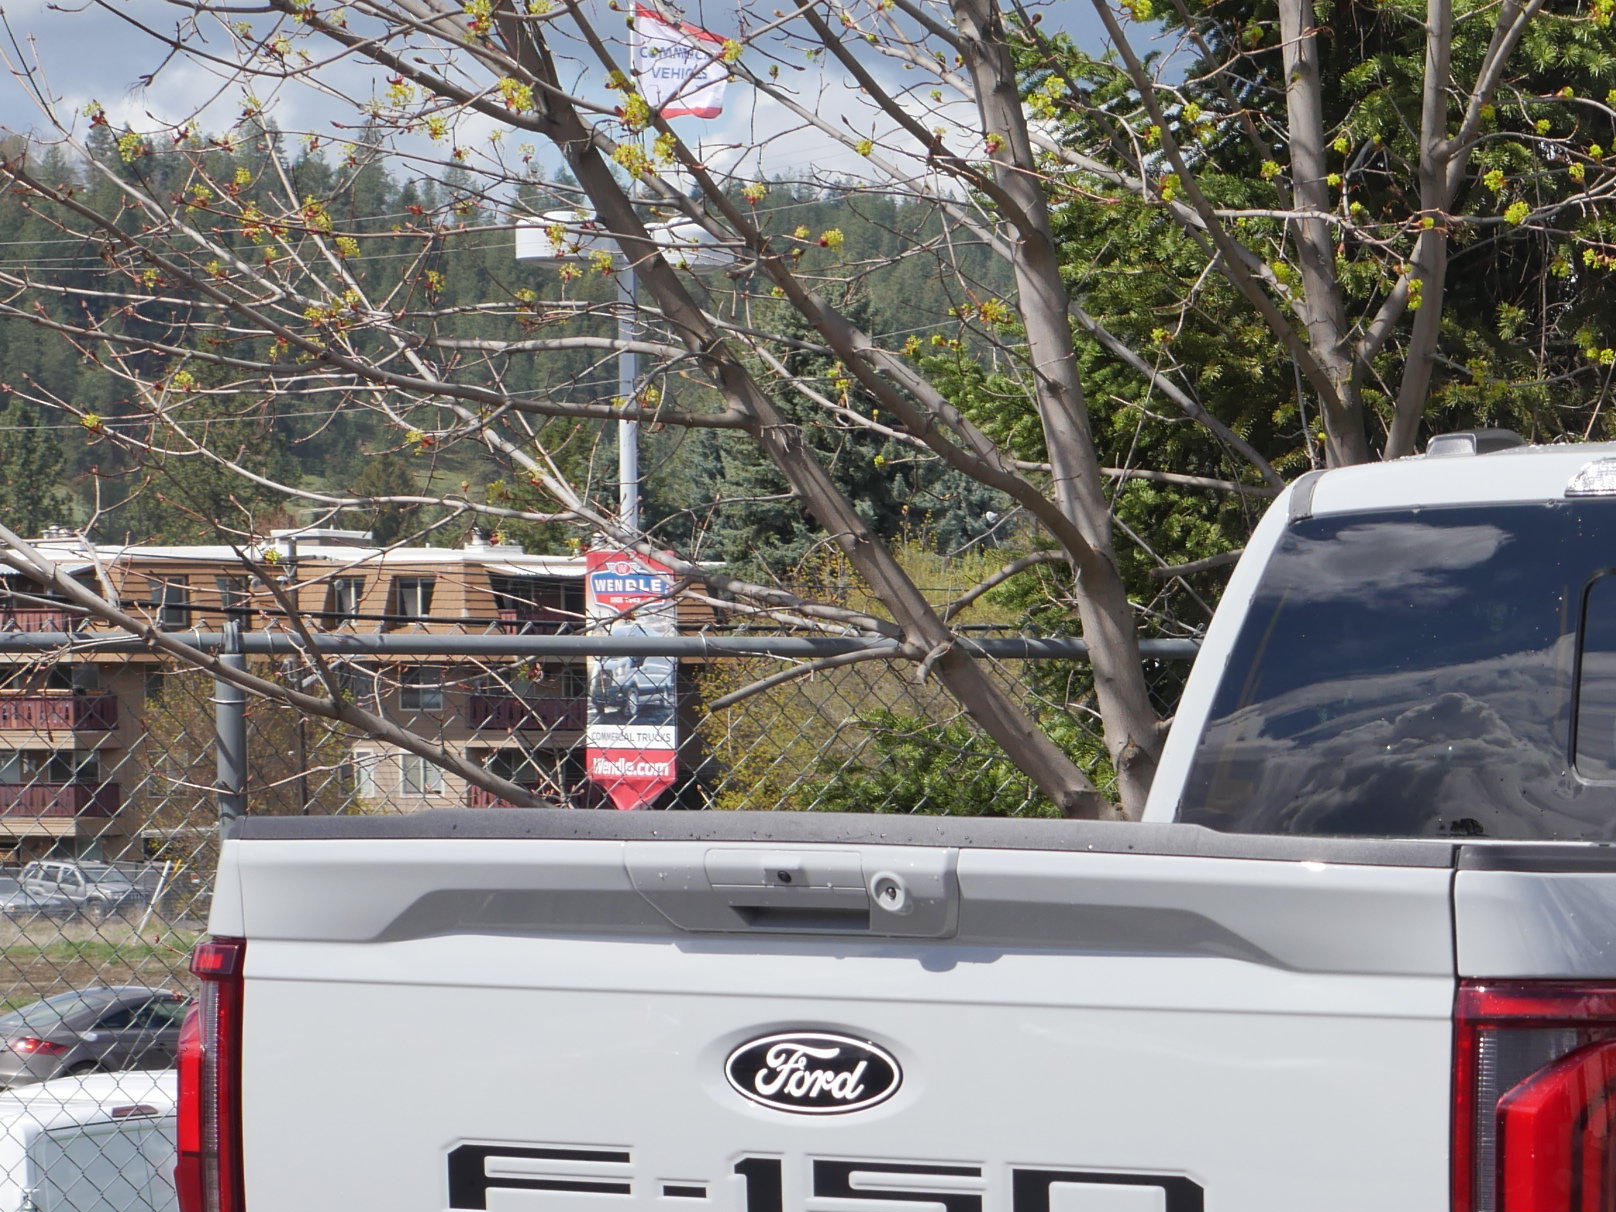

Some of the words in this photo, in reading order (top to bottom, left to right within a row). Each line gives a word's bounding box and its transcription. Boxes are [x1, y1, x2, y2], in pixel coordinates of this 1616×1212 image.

[652, 67, 708, 80] VEHICS
[594, 578, 662, 592] WENDLE
[592, 757, 670, 776] Wendle.com
[754, 1042, 868, 1101] Ford
